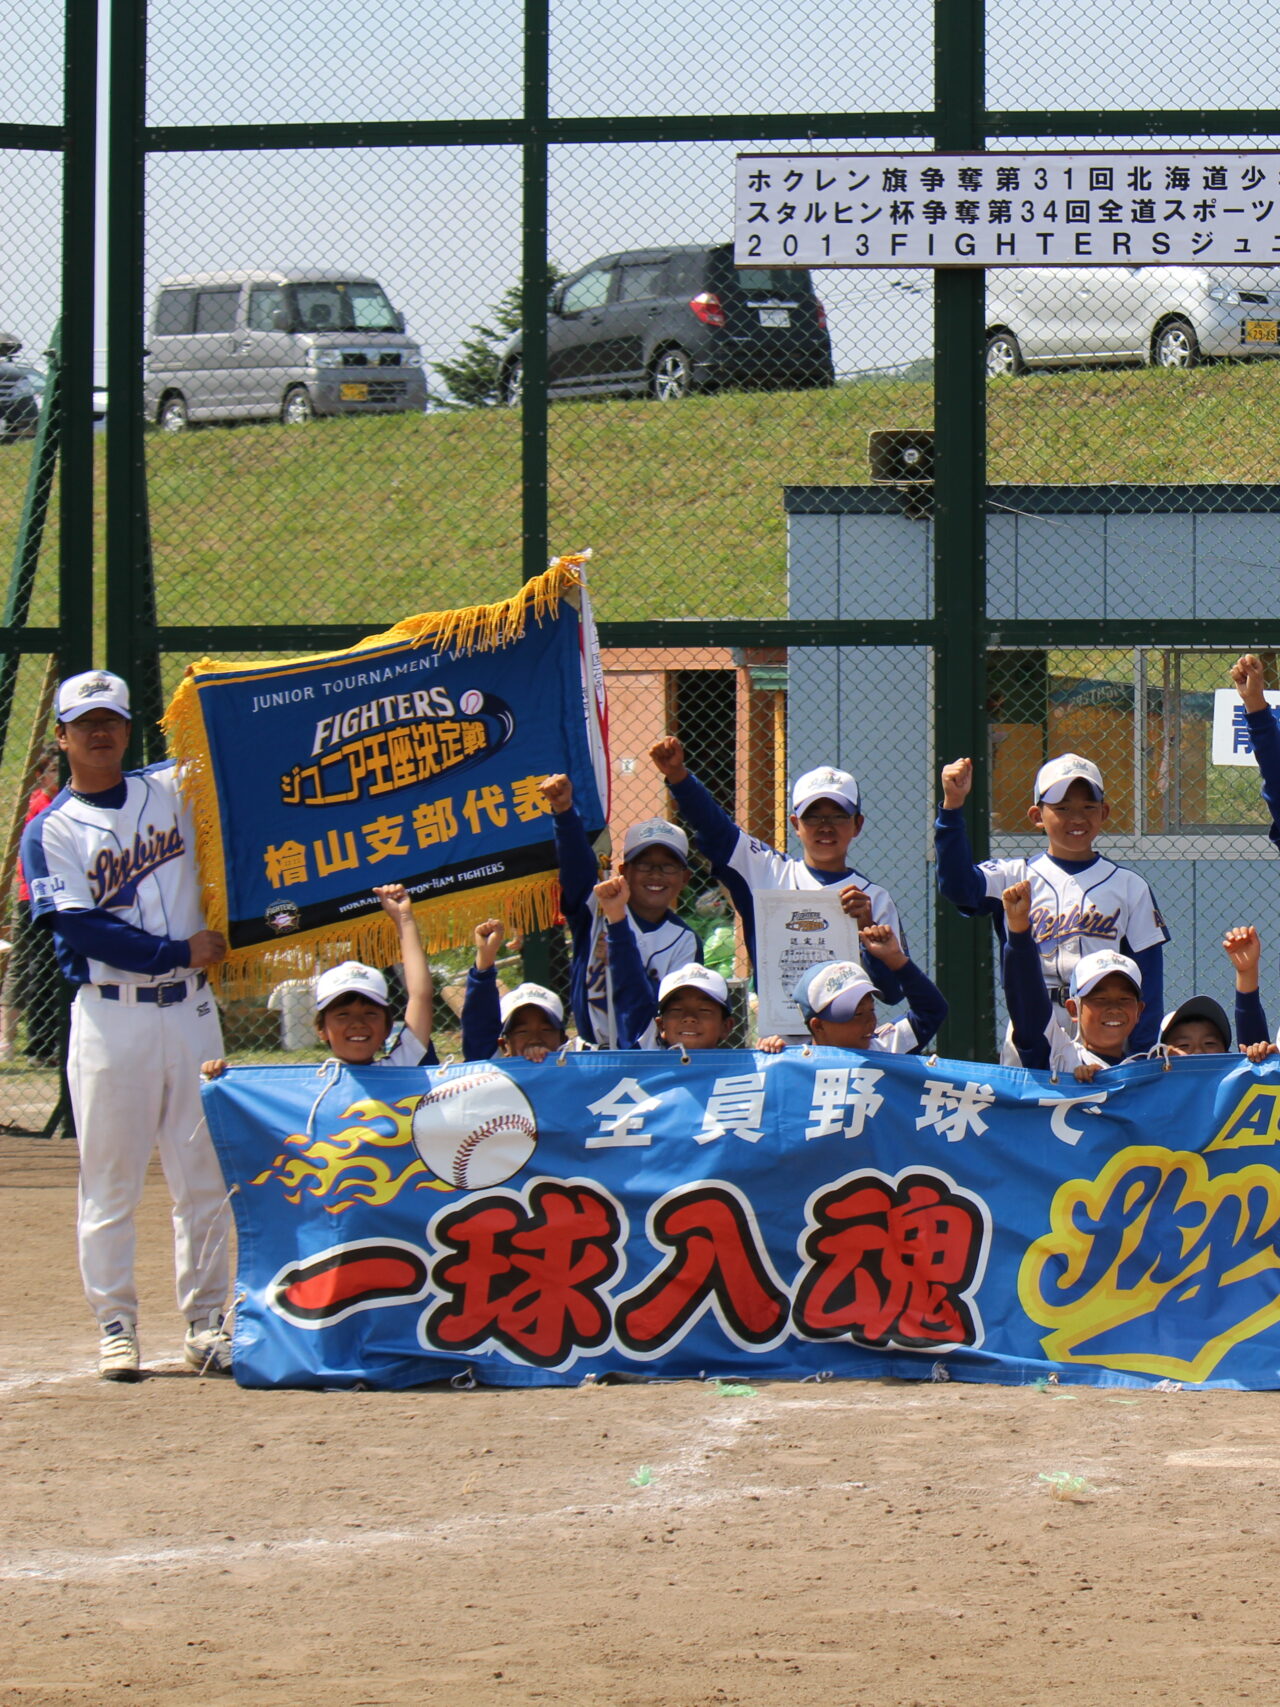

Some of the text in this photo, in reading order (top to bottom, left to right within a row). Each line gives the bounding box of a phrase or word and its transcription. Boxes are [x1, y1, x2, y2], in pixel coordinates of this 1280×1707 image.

[253, 686, 315, 713] JUNIOR
[322, 653, 442, 695] TOURNAMENT
[310, 686, 456, 758] FIGHTERS
[87, 813, 184, 900] Skybird
[264, 775, 553, 889] 檜山支部代表
[339, 862, 505, 913] HOKKAI PPON-HAM FIGHTERS
[585, 1068, 1107, 1149] 全員野球で
[268, 1165, 992, 1372] 一球入魂
